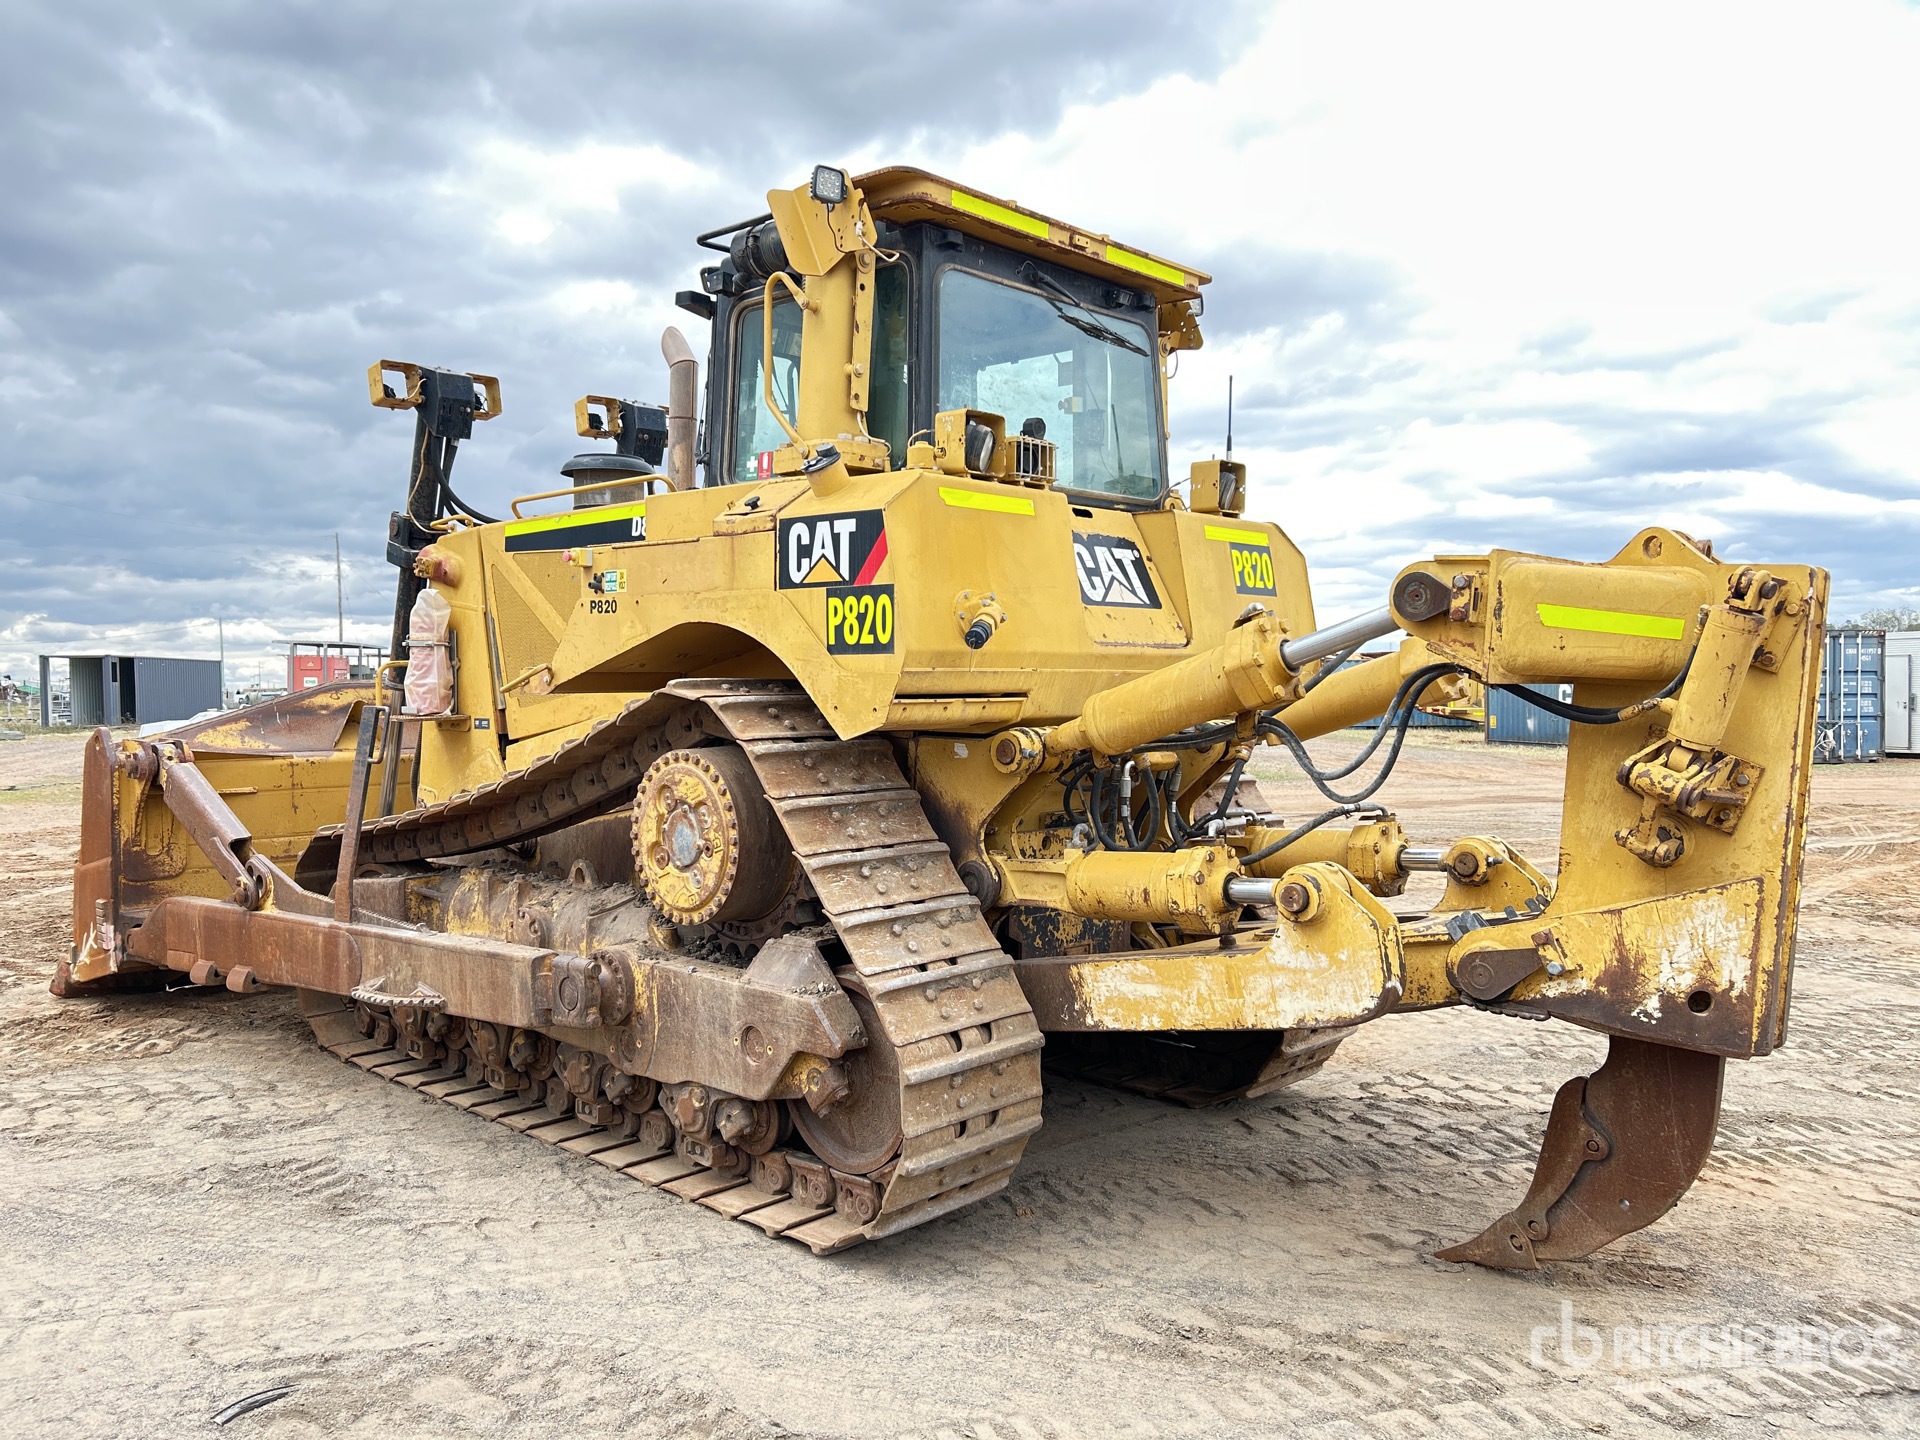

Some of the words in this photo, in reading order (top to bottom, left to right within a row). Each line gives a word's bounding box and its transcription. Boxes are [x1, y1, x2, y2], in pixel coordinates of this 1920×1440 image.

[788, 518, 857, 584] CAT
[1073, 543, 1150, 604] CAT
[1231, 550, 1275, 589] P820
[590, 600, 617, 614] P820
[828, 594, 893, 645] P820
